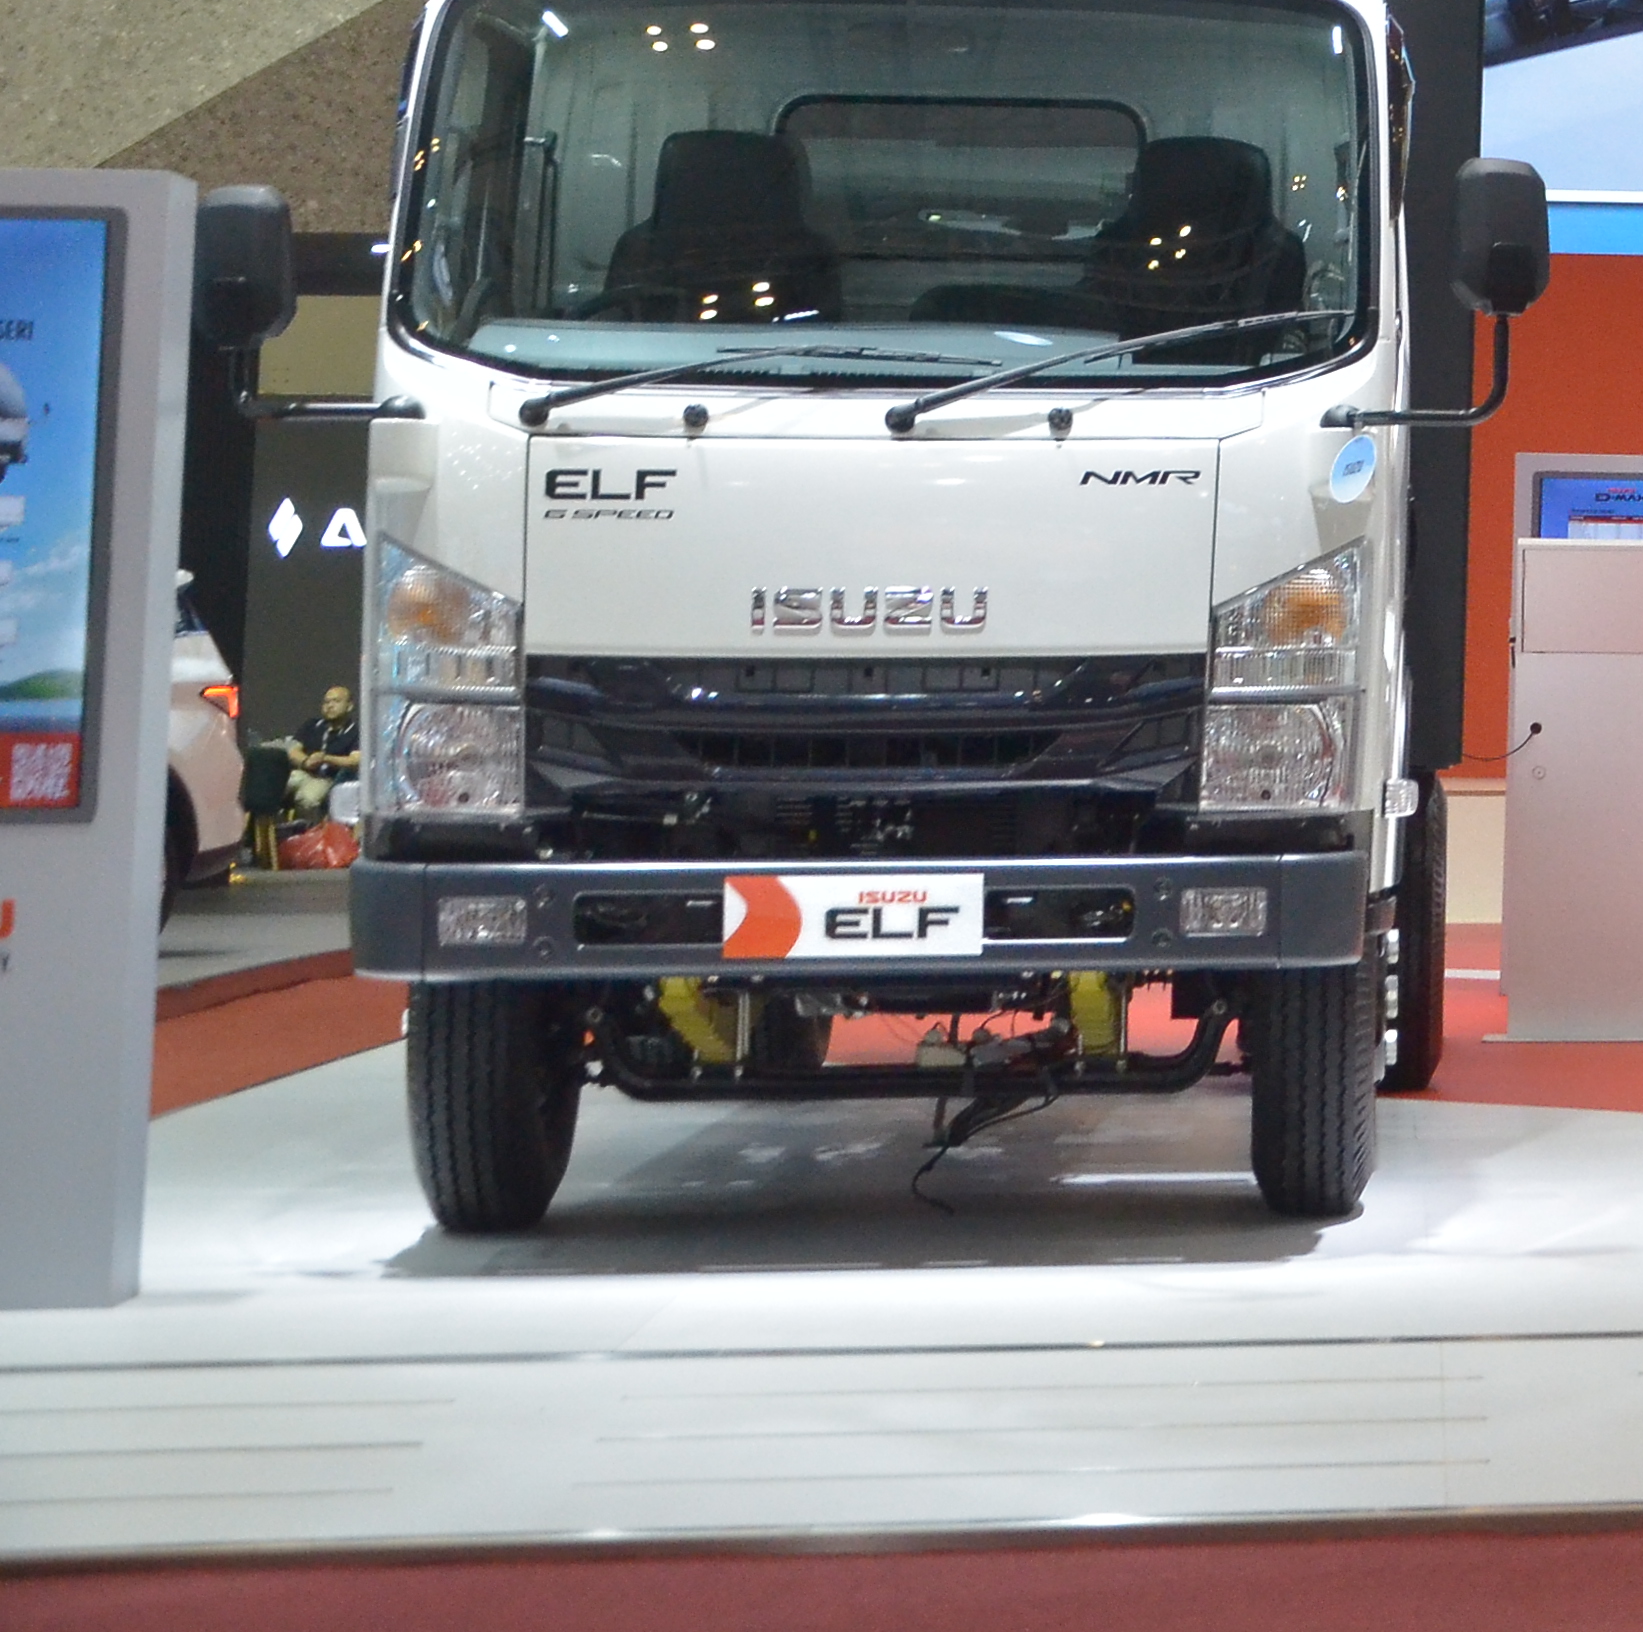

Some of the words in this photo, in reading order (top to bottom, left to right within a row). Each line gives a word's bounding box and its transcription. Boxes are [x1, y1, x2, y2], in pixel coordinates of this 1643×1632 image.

[545, 469, 677, 500] ELF
[1079, 470, 1201, 485] NMR
[572, 509, 674, 519] SPEED
[751, 586, 989, 630] ISUZU
[859, 891, 928, 904] ISUZU
[825, 906, 960, 939] ELF
